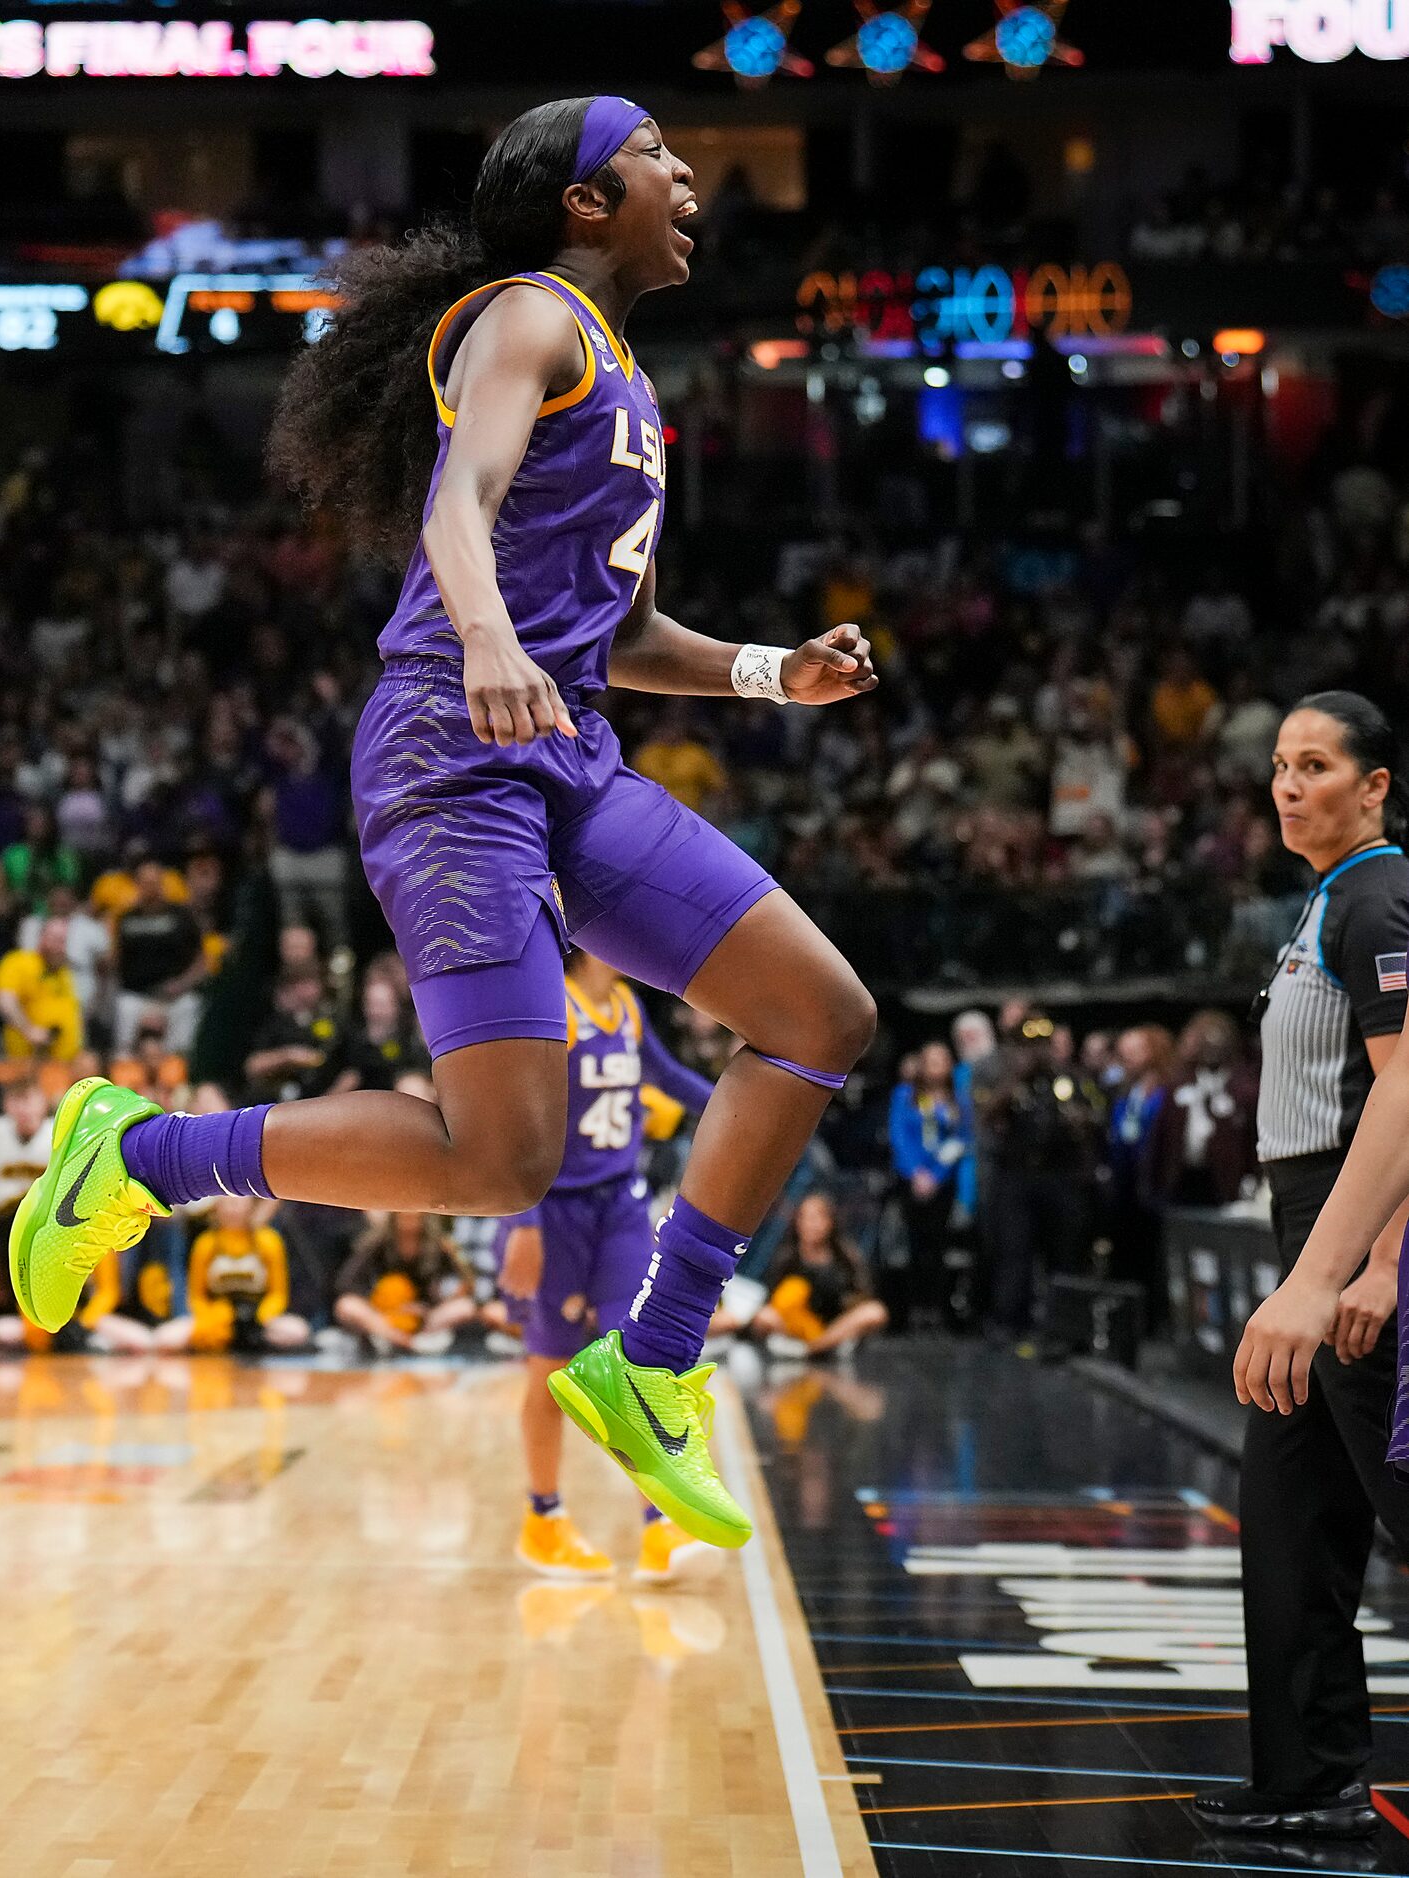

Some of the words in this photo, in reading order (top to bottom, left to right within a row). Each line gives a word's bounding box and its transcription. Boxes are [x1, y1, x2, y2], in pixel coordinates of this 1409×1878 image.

[45, 19, 247, 77] FINAL
[247, 18, 437, 78] FOUR
[1228, 0, 1409, 64] FOU
[608, 498, 659, 606] 4
[579, 1053, 641, 1089] LSU
[578, 1089, 634, 1150] 45
